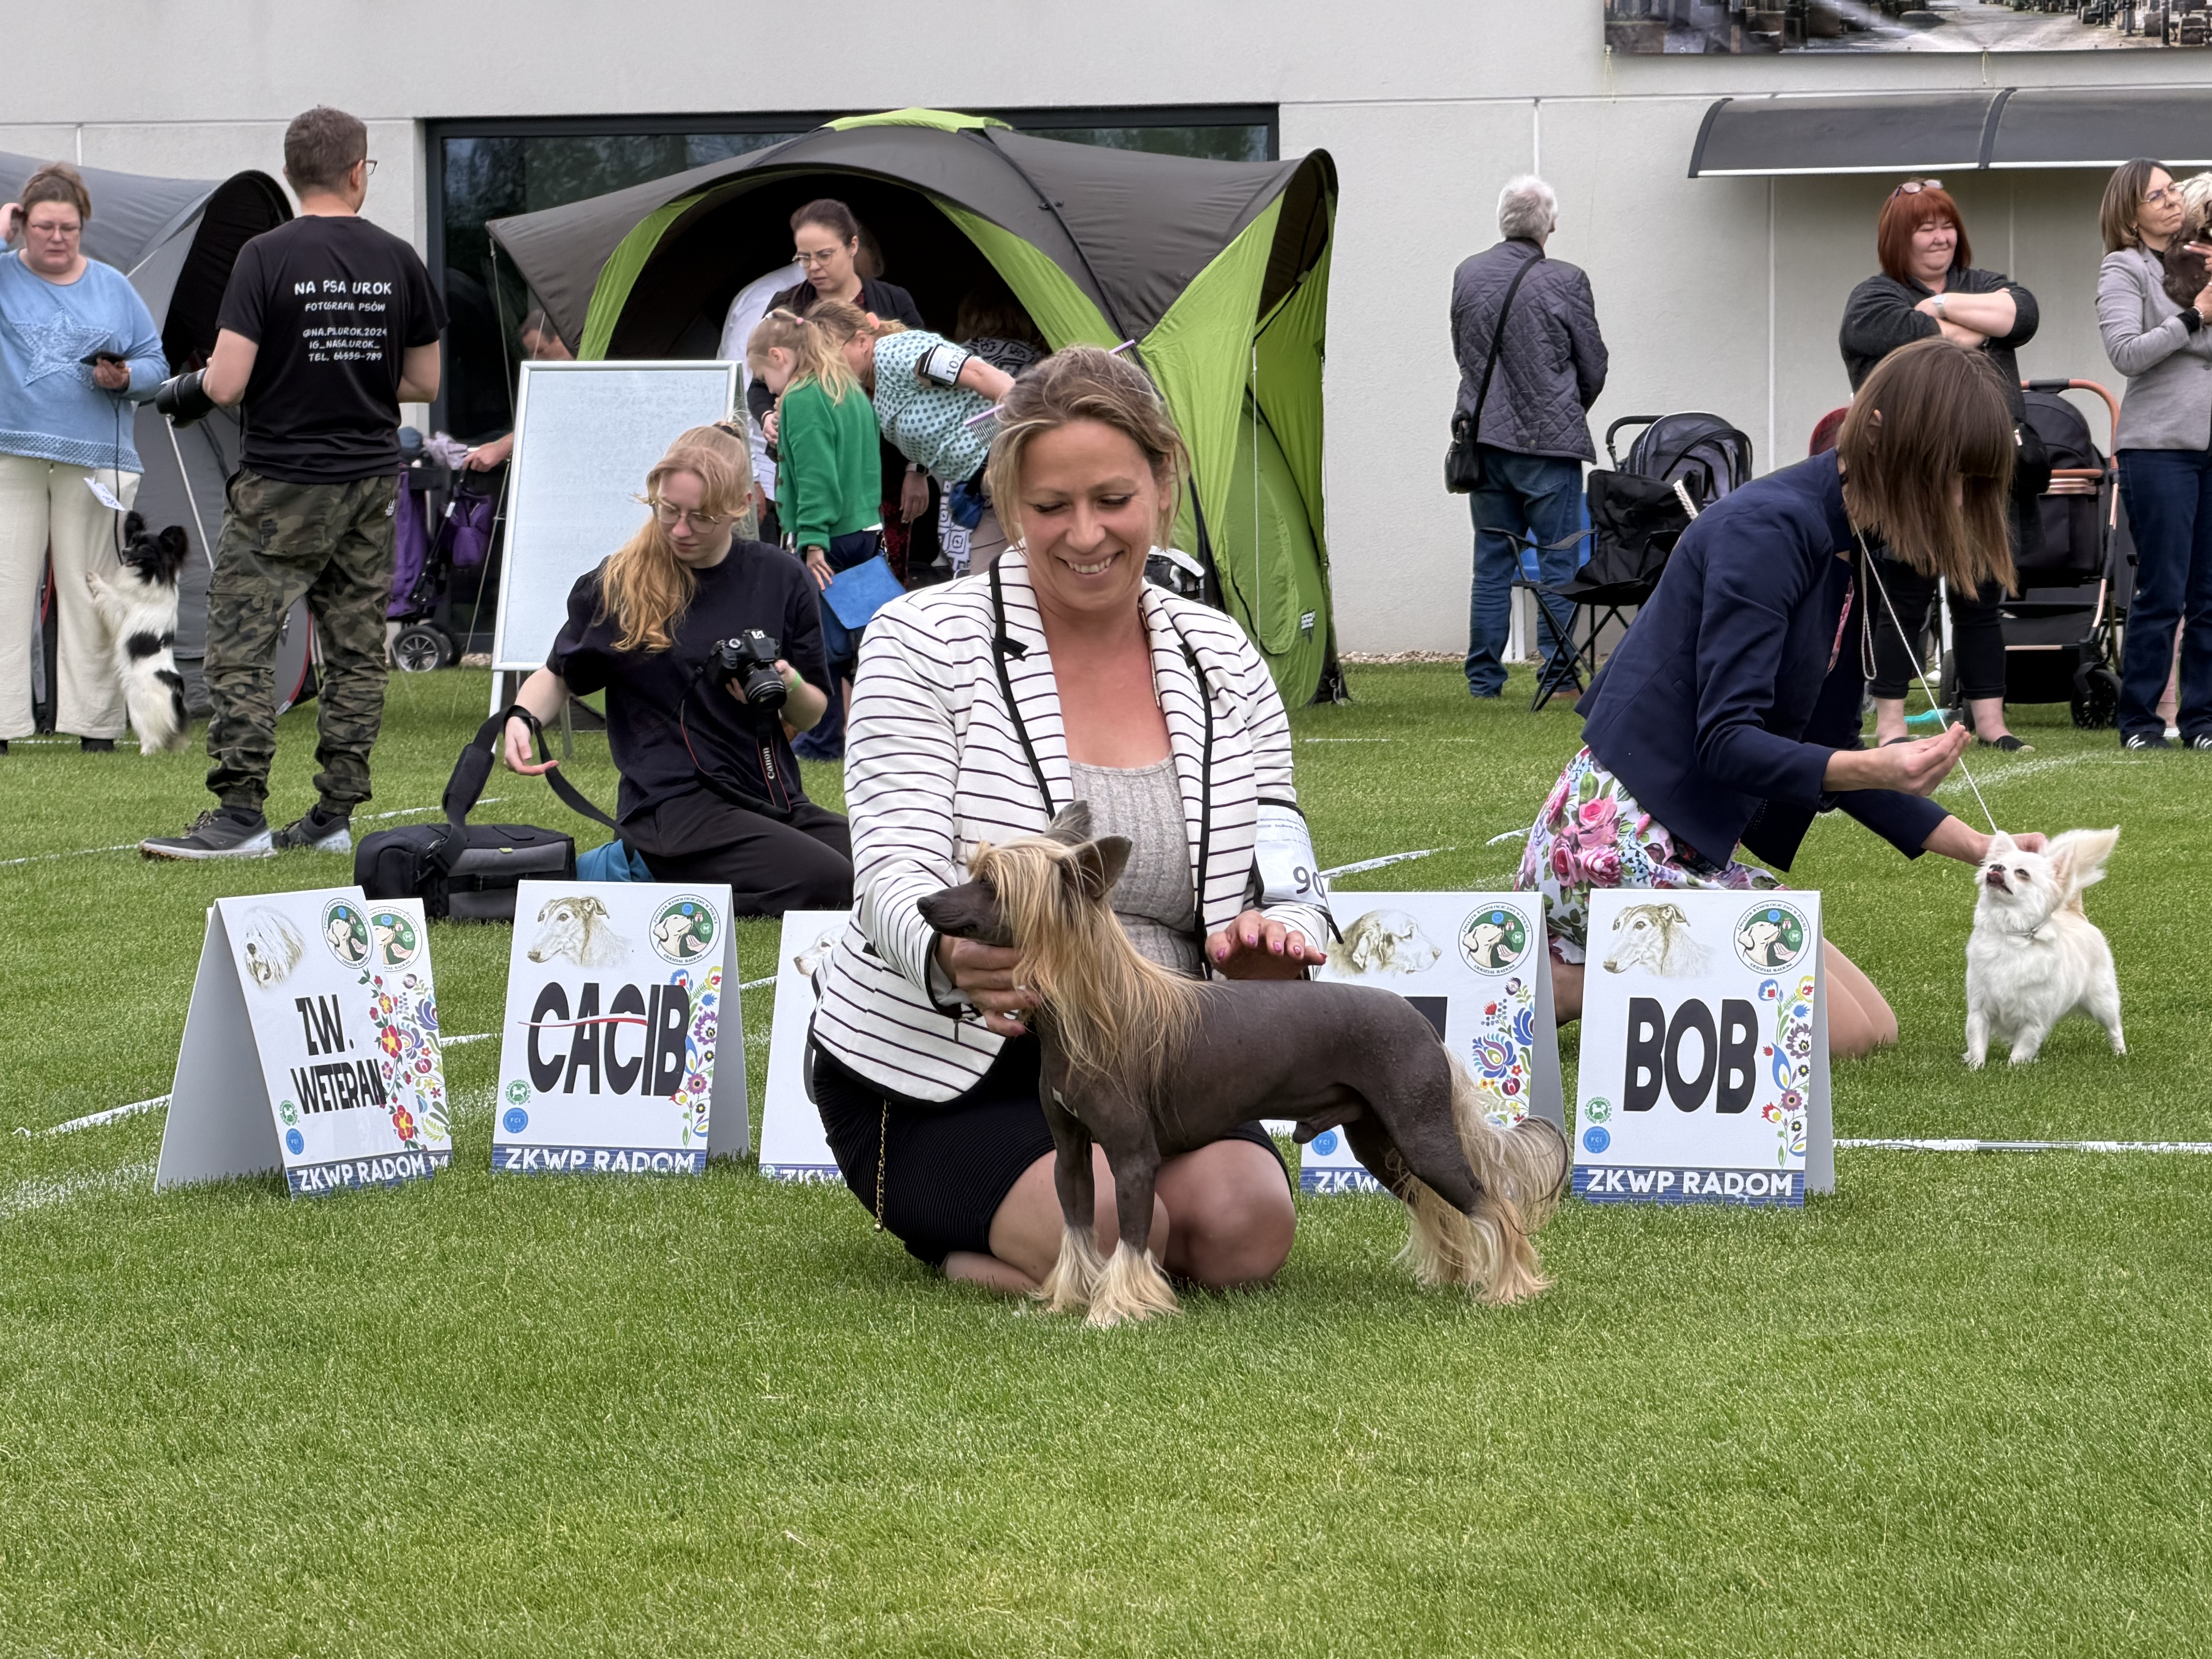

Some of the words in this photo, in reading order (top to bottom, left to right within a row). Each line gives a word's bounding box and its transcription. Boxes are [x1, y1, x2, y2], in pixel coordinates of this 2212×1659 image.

[295, 281, 316, 295] NA
[323, 280, 346, 293] PSA
[352, 282, 392, 295] UROK
[359, 301, 385, 312] PSÓW
[308, 353, 329, 362] TEL.
[763, 747, 775, 779] Canon
[528, 982, 690, 1096] CACIB
[1623, 997, 1759, 1114] BOB
[290, 1058, 387, 1114] WETERAN
[297, 1164, 353, 1191] ZKWP
[356, 1154, 426, 1184] RADOM
[505, 1148, 586, 1170] ZKWP
[594, 1151, 696, 1173] RADOM
[1587, 1169, 1675, 1193] ZKWP
[1683, 1171, 1793, 1196] RADOM
